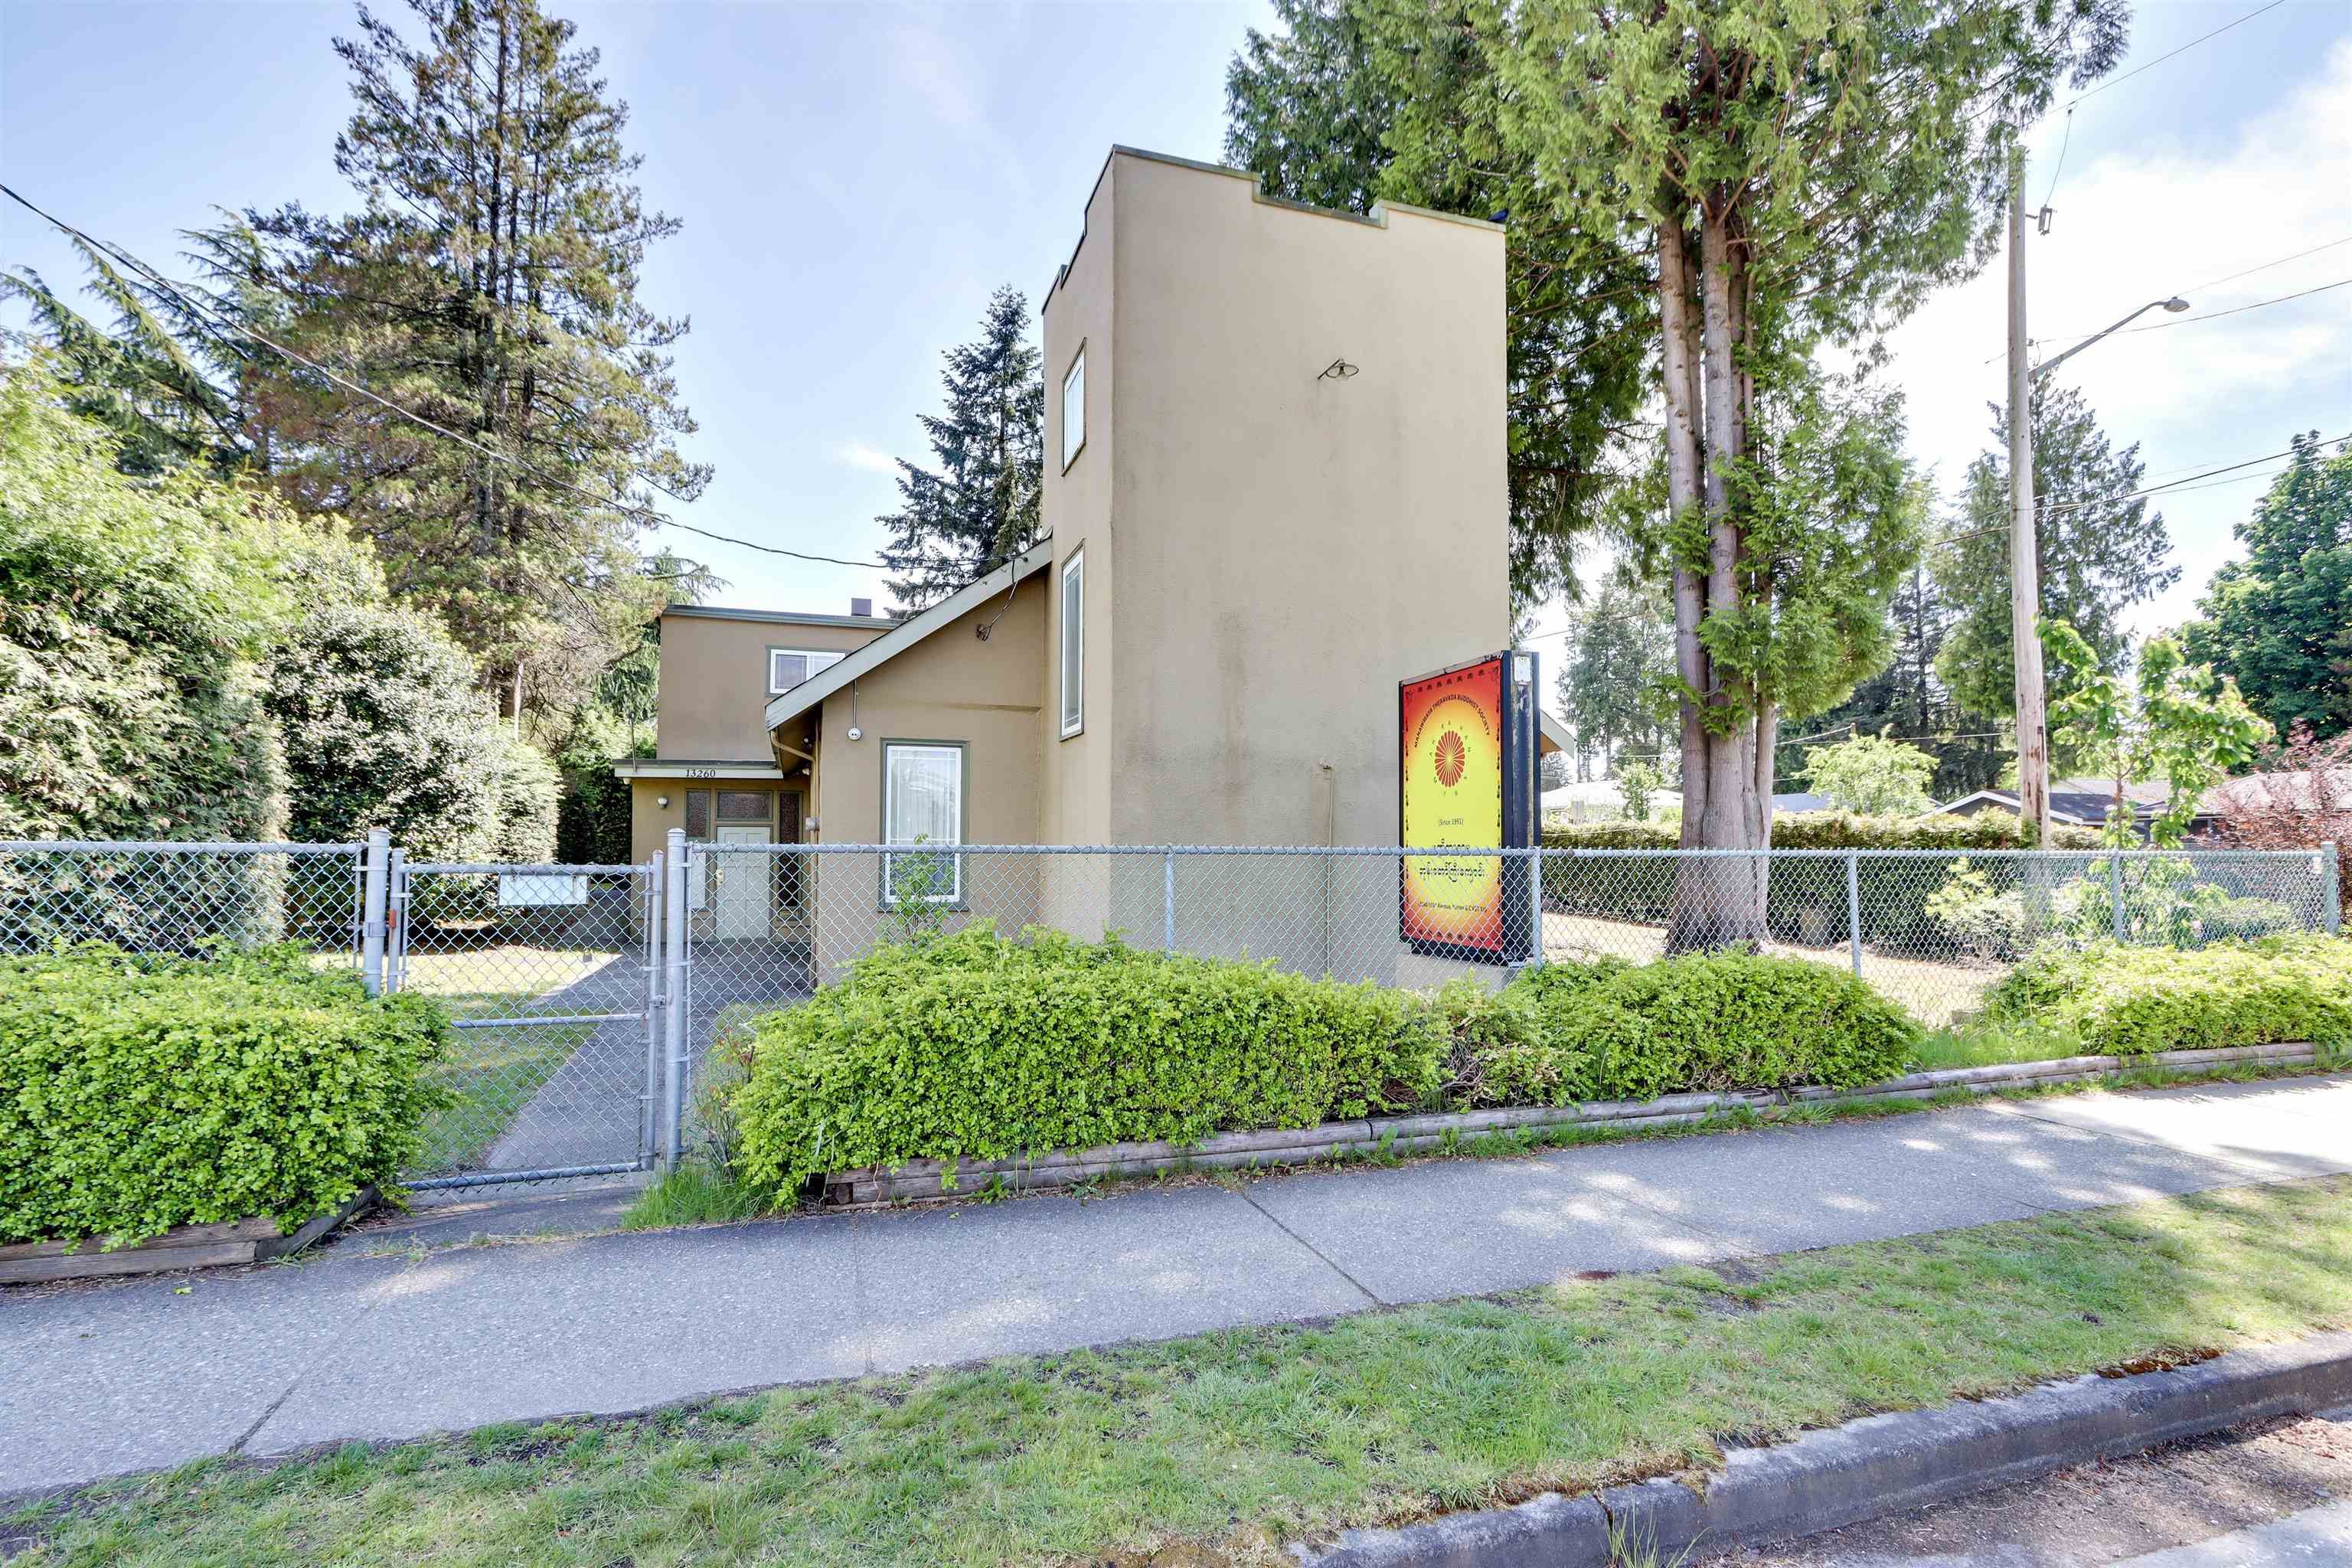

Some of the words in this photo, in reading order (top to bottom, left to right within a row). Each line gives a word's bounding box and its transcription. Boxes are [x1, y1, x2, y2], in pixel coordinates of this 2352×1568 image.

[1432, 694, 1457, 710] THERAVADA
[1457, 694, 1479, 711] BUDDHIST
[1477, 708, 1491, 736] SOCIETY
[686, 769, 716, 779] 13260
